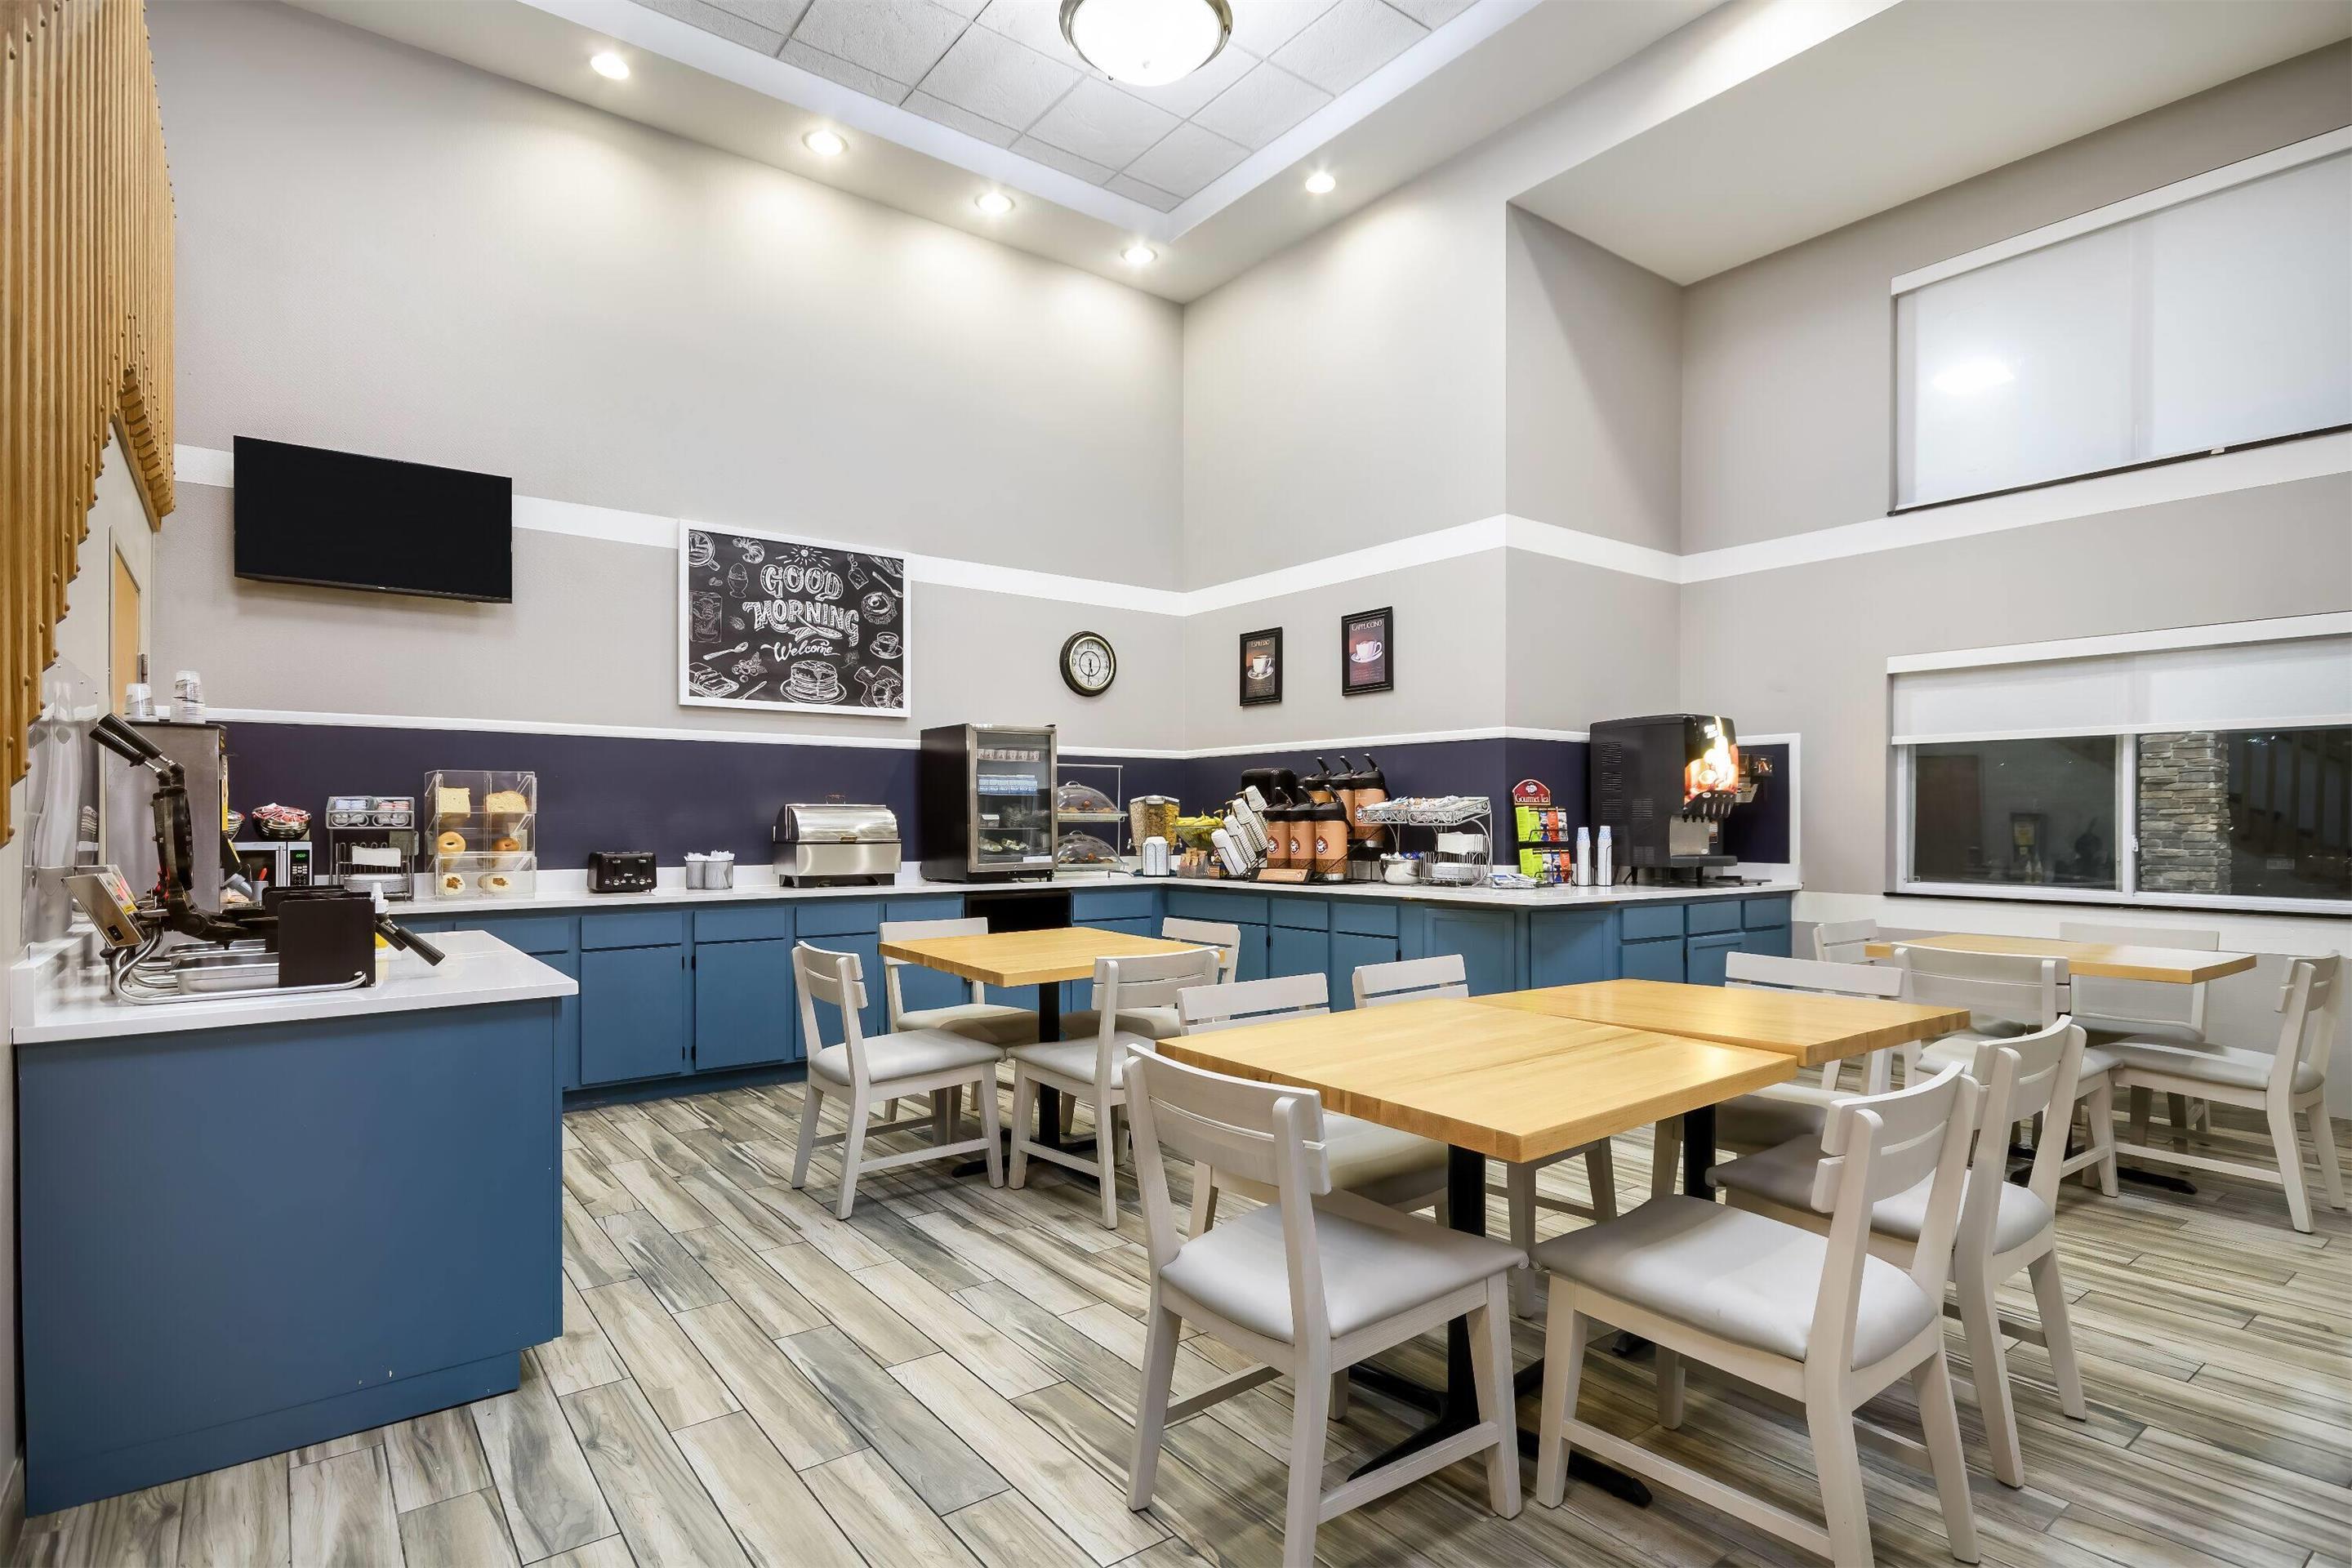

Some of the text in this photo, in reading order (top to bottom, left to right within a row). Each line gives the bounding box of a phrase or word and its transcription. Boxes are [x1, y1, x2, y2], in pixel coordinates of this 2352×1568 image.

[760, 564, 844, 600] GOOD
[742, 599, 860, 648] MORNING
[760, 639, 841, 662] Welcome
[1539, 794, 1549, 803] Tea
